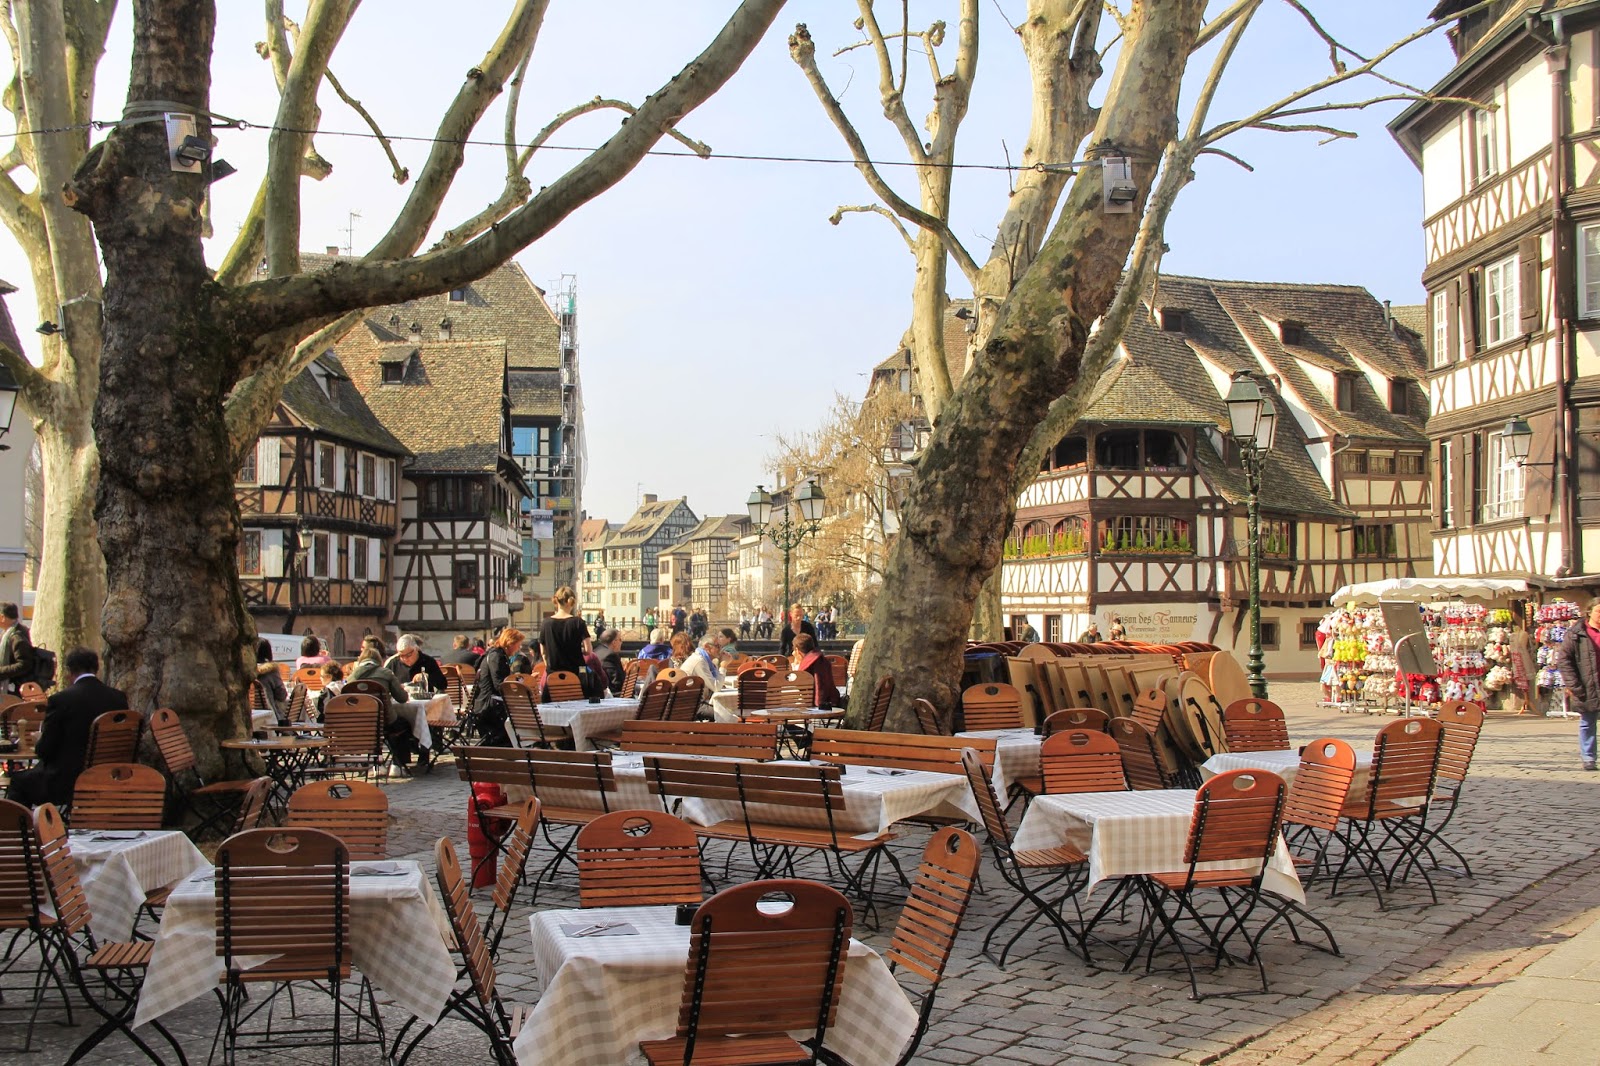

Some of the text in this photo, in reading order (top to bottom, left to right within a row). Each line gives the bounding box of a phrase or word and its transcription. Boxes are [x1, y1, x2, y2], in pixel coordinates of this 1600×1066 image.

[1103, 609, 1198, 625] Maison des Tanneurs
